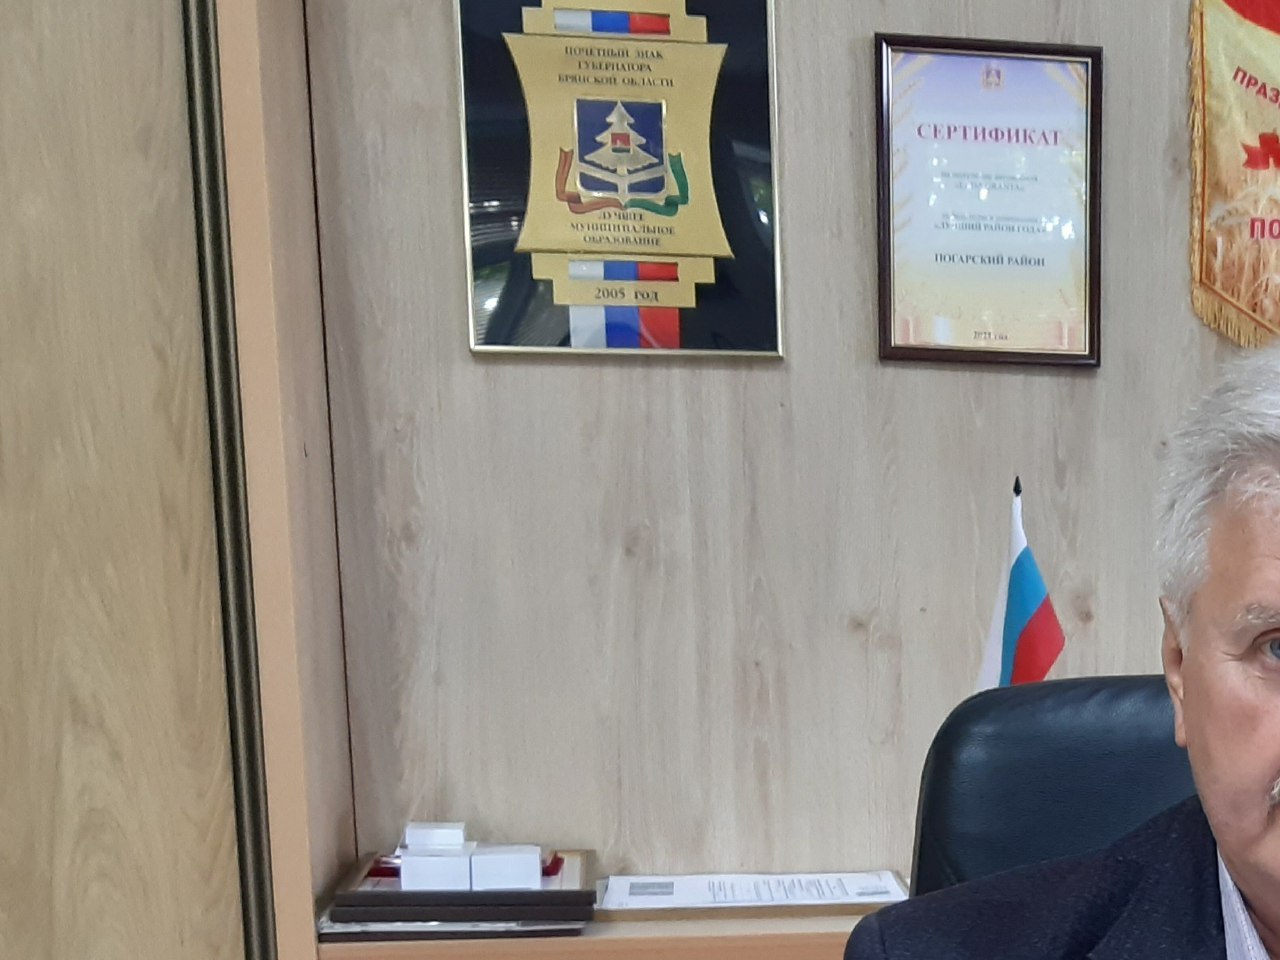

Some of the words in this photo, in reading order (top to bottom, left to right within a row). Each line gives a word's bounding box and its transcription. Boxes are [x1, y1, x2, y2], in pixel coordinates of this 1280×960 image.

[917, 122, 1062, 147] СЕРТИФИКАТ
[935, 252, 1004, 266] ПОГАРСКИЙ
[1007, 254, 1045, 267] РАЙОН
[595, 288, 625, 299] 2005
